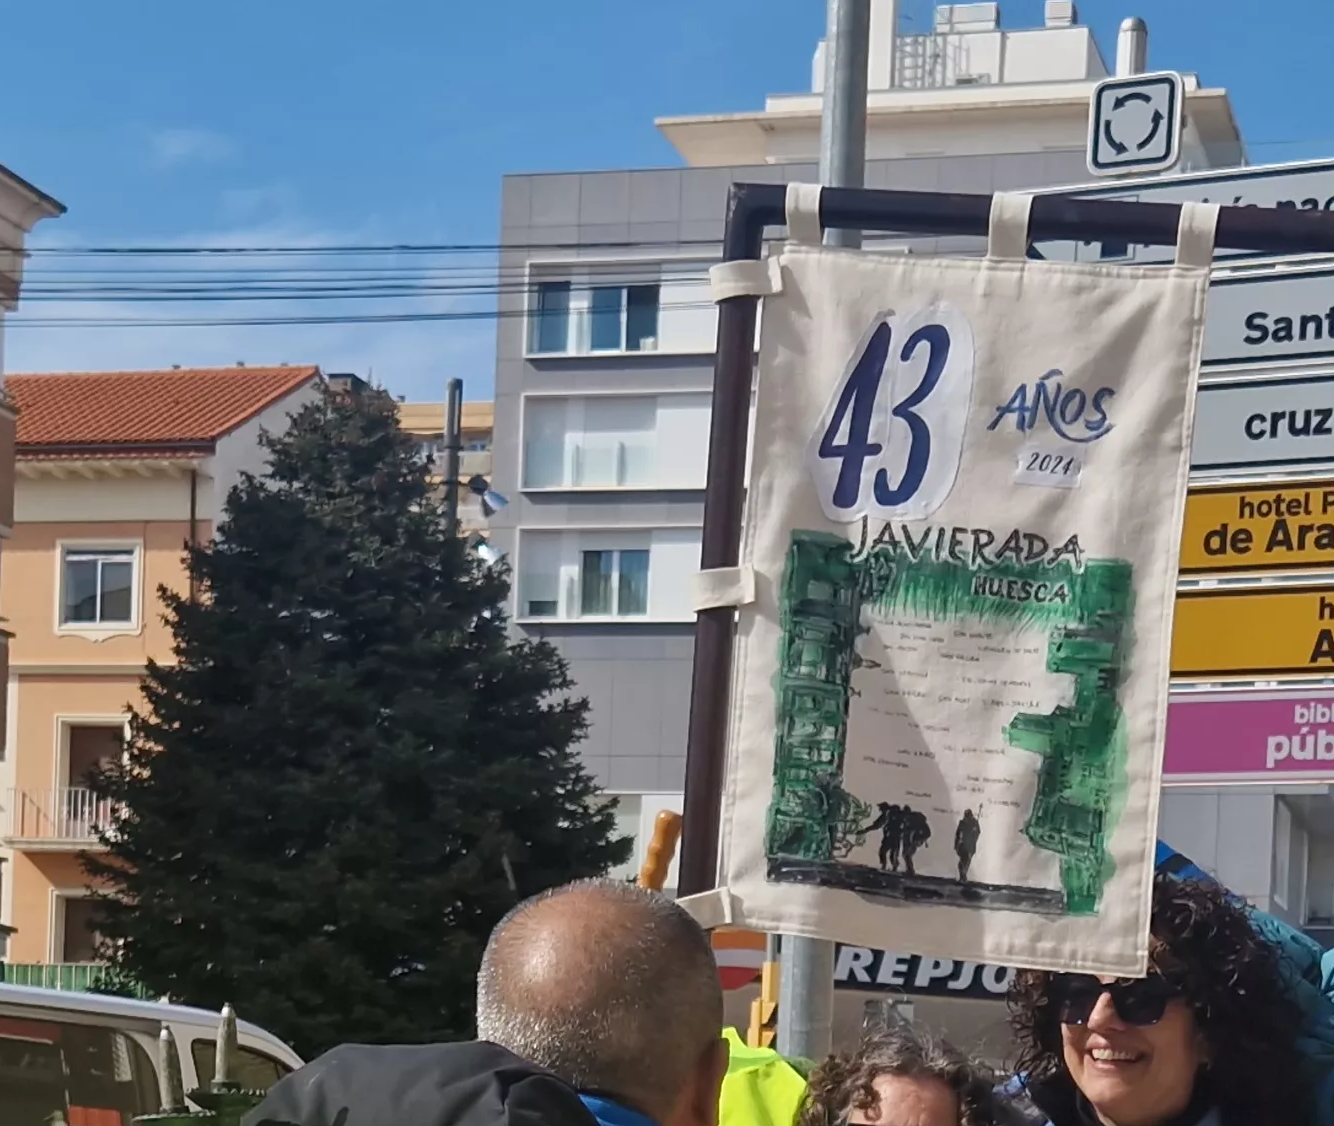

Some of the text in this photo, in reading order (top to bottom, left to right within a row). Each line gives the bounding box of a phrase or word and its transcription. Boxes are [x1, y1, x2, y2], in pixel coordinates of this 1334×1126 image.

[818, 321, 951, 508] 43
[986, 368, 1116, 443] AÑOS
[1244, 407, 1334, 441] cruz
[1026, 451, 1075, 476] 2024
[1238, 492, 1312, 520] hotel
[849, 514, 1086, 573] JAVIERADA
[1203, 523, 1254, 556] de
[972, 573, 1069, 604] HUESCA
